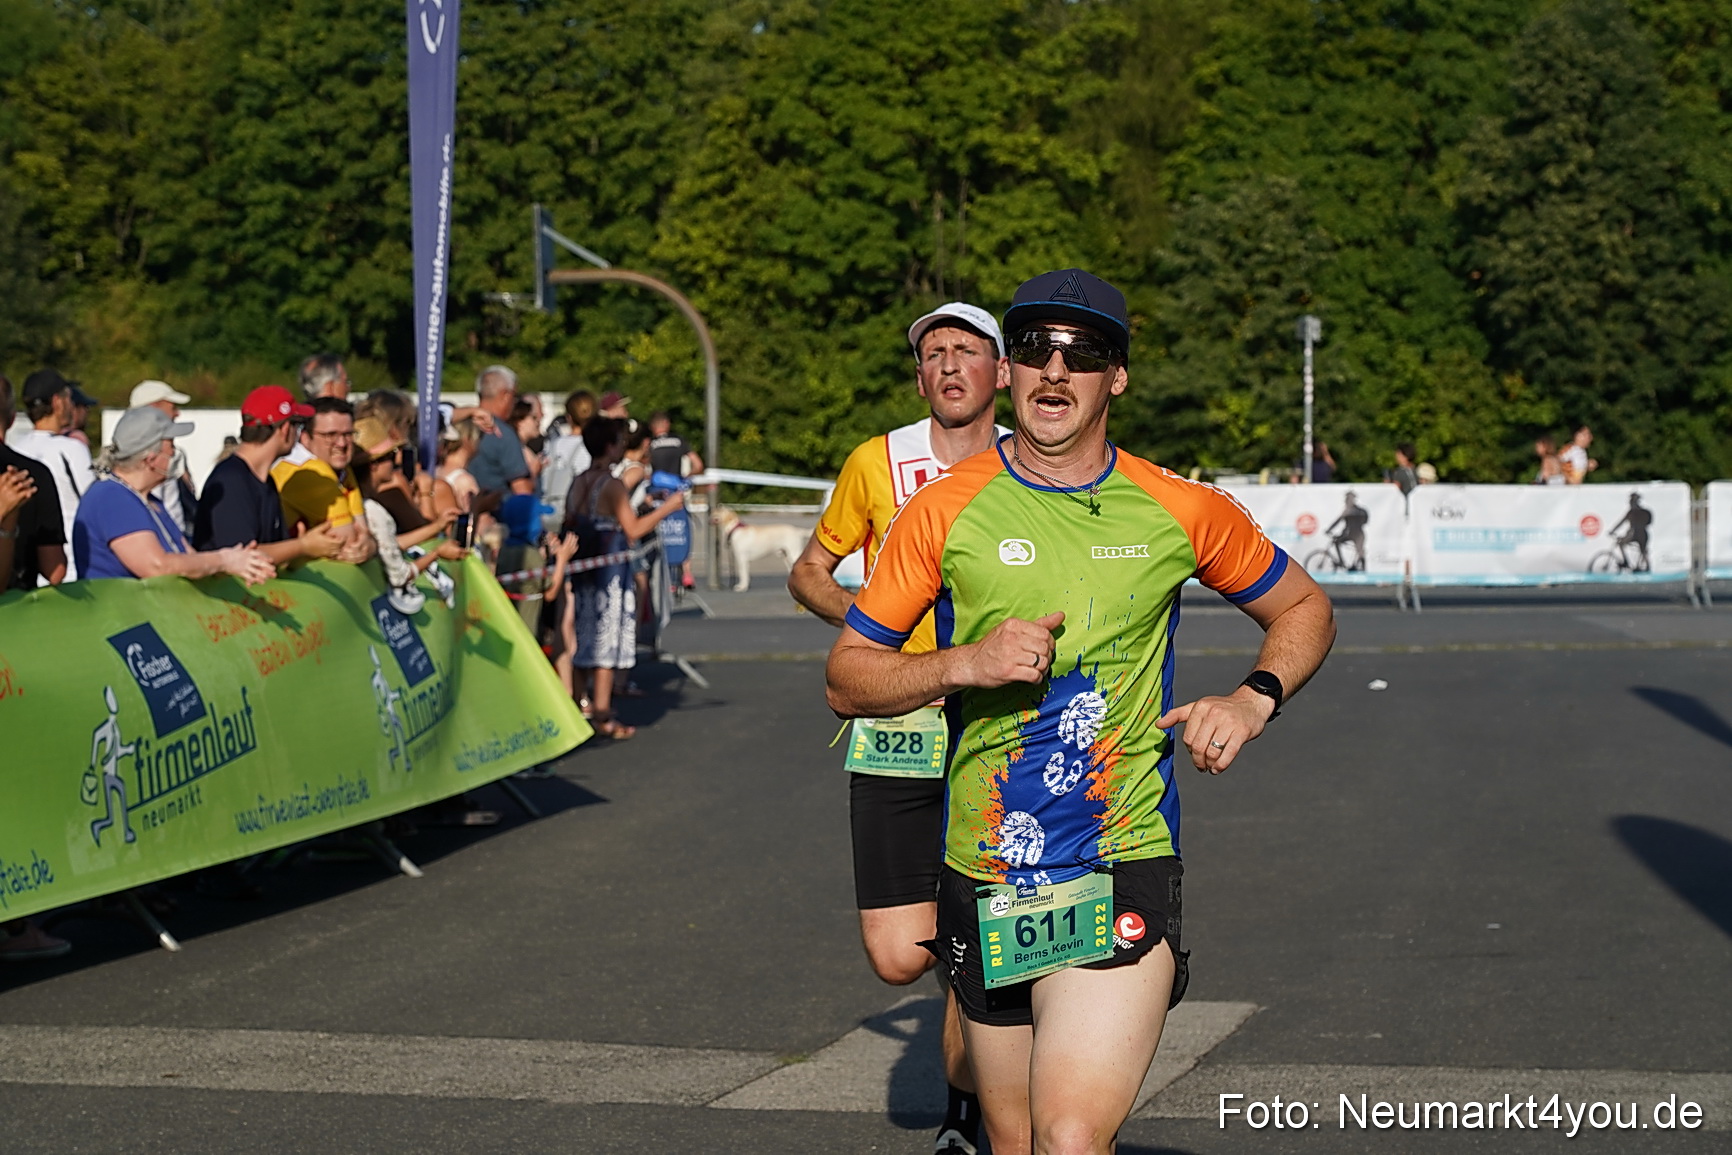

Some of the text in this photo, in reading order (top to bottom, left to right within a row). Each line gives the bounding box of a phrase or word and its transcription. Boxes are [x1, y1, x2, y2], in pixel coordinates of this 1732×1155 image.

[1092, 545, 1150, 558] BOCK
[134, 686, 256, 802] firmenlauf
[853, 735, 867, 760] RUN
[875, 731, 924, 754] 828
[931, 735, 944, 768] 2022
[866, 754, 929, 765] Stark Andreas
[142, 786, 203, 831] neumarkt
[1012, 892, 1054, 908] Firmenlauf
[1029, 900, 1055, 910] neumarkt
[1014, 905, 1076, 948] 611
[1094, 902, 1107, 948] 2022
[988, 931, 1004, 968] RUN
[1014, 938, 1084, 965] Berns Kevin
